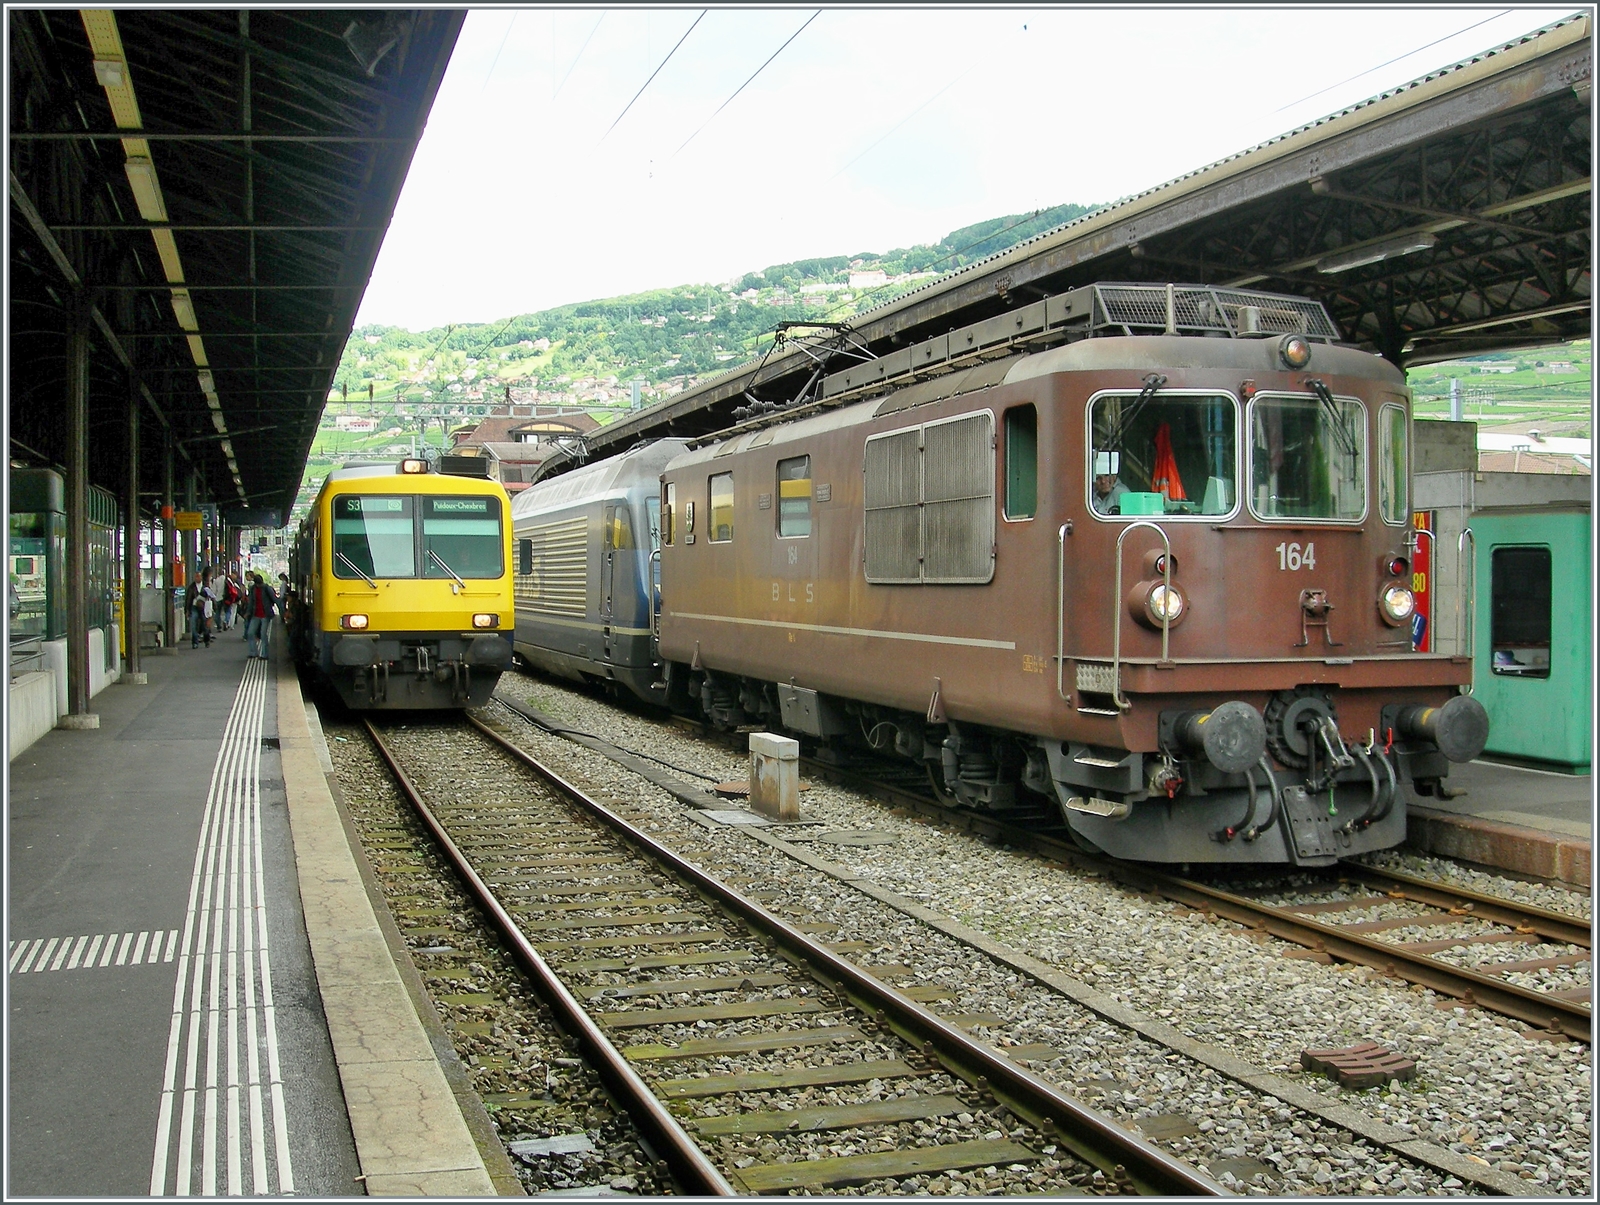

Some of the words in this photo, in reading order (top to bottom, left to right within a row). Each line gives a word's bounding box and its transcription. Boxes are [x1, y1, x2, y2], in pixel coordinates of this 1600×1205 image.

[347, 499, 360, 511] S3
[433, 501, 486, 510] Puidoux-Chexbres
[202, 509, 210, 521] 5
[1275, 542, 1316, 571] 164
[1412, 572, 1426, 593] 80
